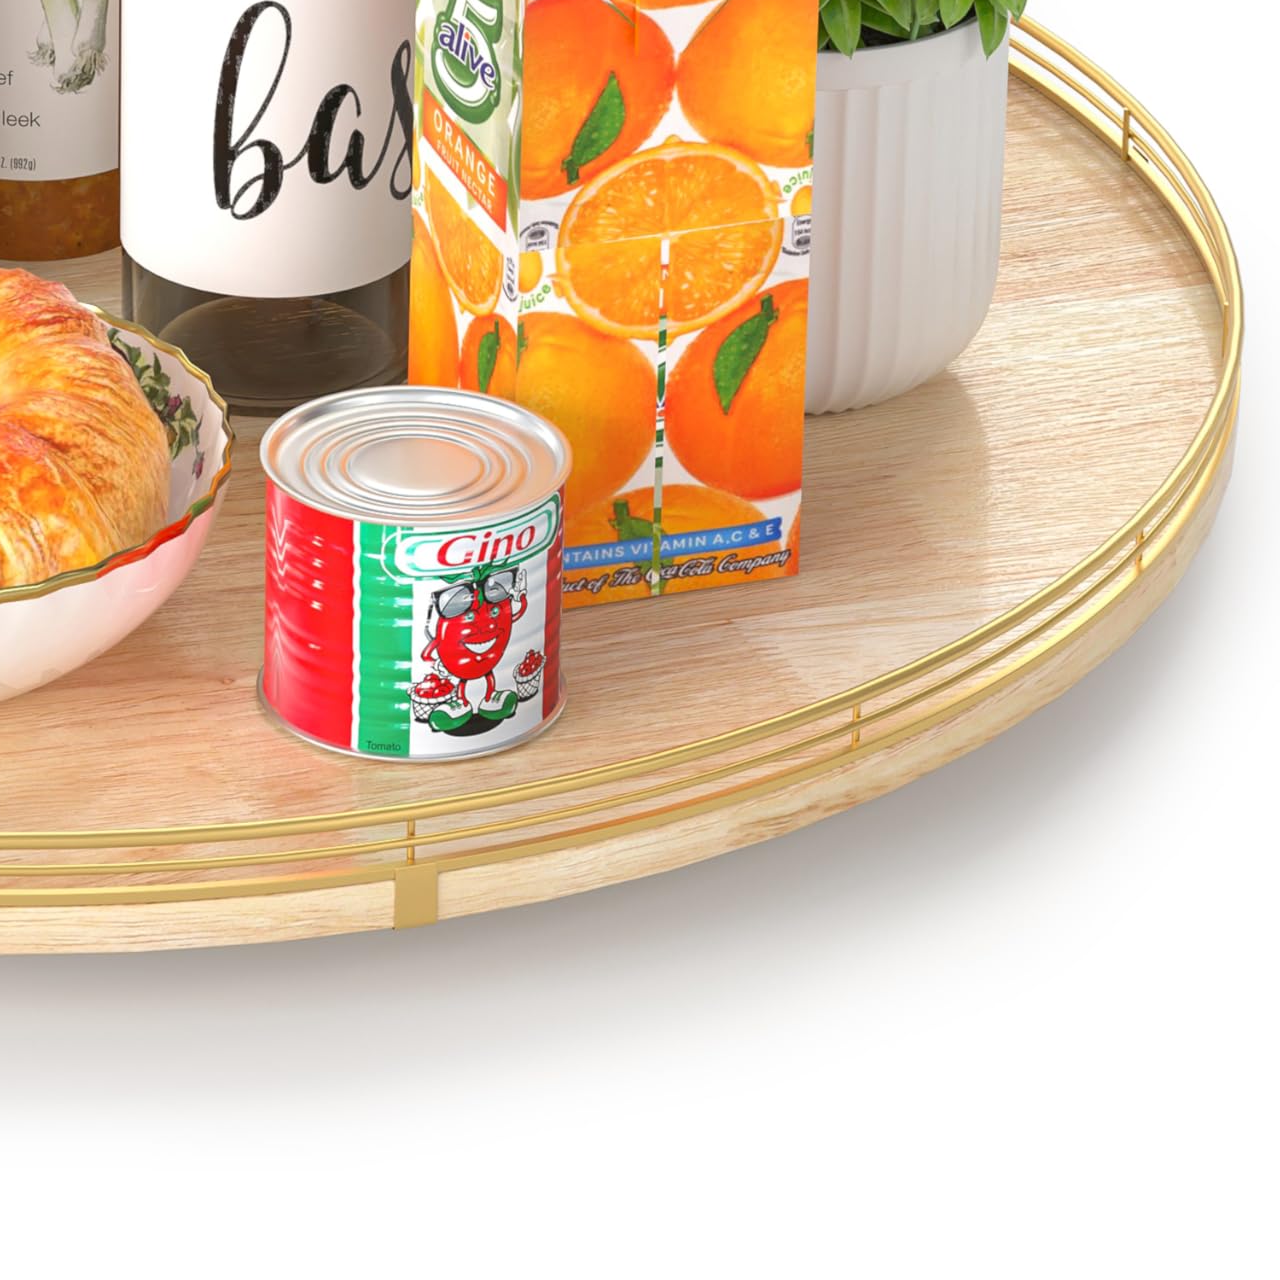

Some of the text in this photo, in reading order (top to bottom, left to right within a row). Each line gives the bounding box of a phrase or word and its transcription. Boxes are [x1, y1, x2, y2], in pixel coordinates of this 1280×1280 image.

[438, 22, 497, 91] alive
[2, 110, 41, 127] leek
[433, 108, 496, 197] ORANGE
[437, 139, 492, 210] FRUIT NECTAR
[436, 524, 536, 567] Gino
[630, 534, 707, 556] VIAMIN
[748, 528, 760, 539] &
[765, 523, 775, 536] E
[586, 574, 608, 594] of
[609, 566, 641, 587] The
[717, 549, 792, 574] Company
[365, 740, 402, 752] Tomato
